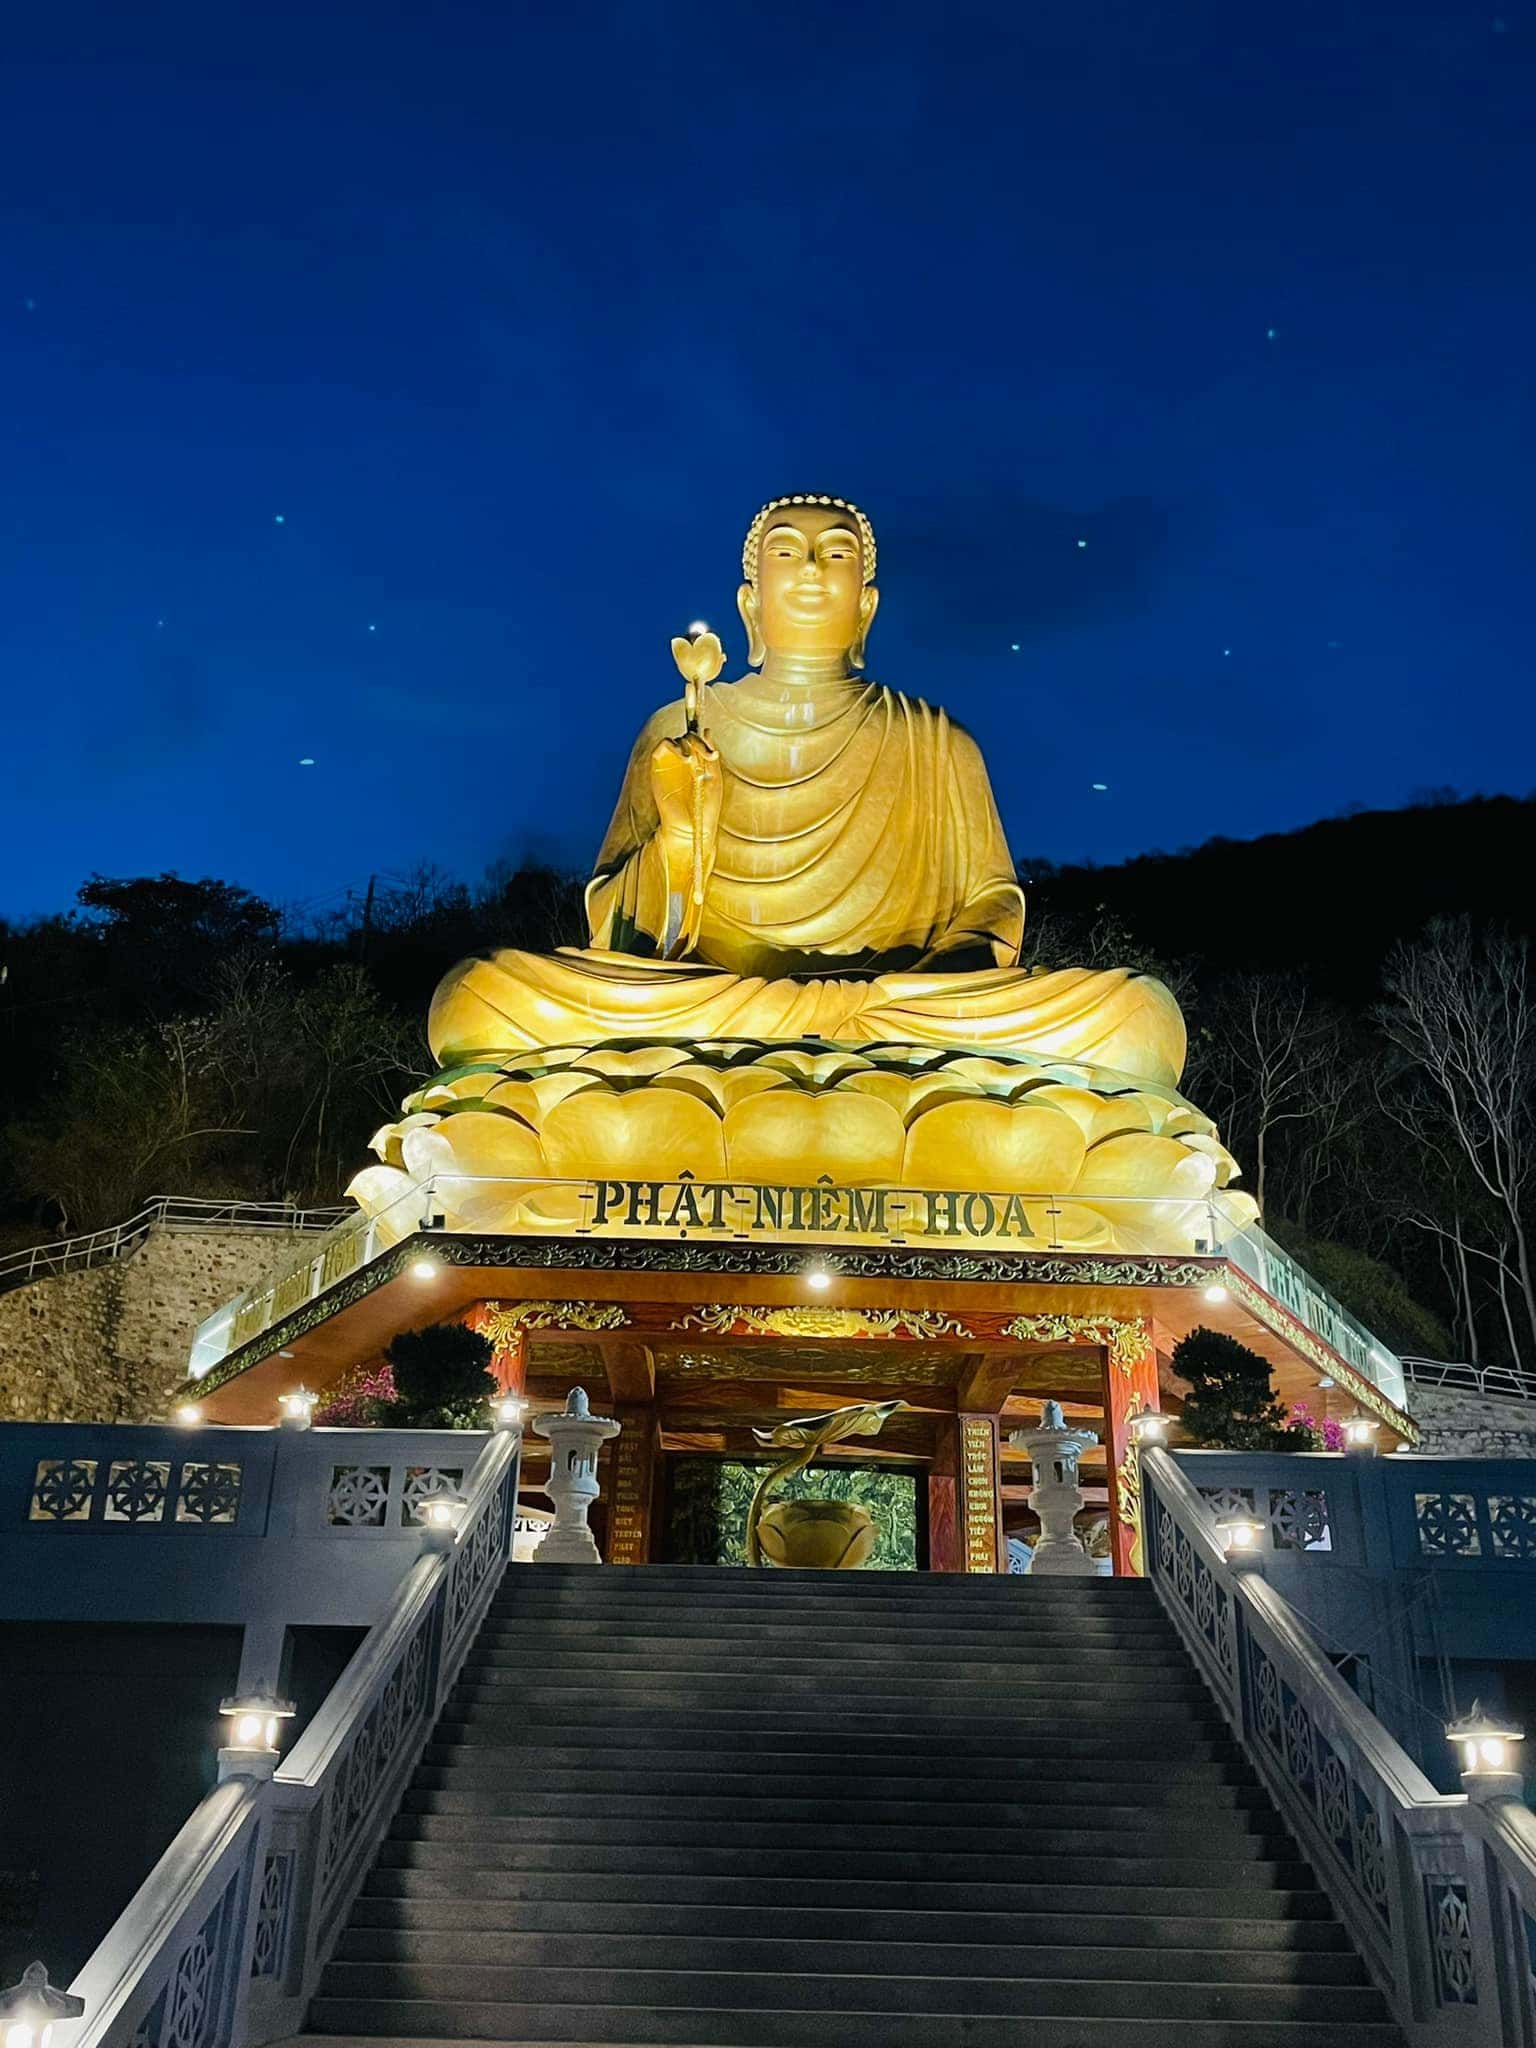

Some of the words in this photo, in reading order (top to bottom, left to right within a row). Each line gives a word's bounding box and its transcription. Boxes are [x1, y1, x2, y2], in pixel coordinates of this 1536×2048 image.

[591, 1169, 735, 1238] PHẬT
[752, 1174, 889, 1234] NIÊM
[923, 1191, 1035, 1238] HOA
